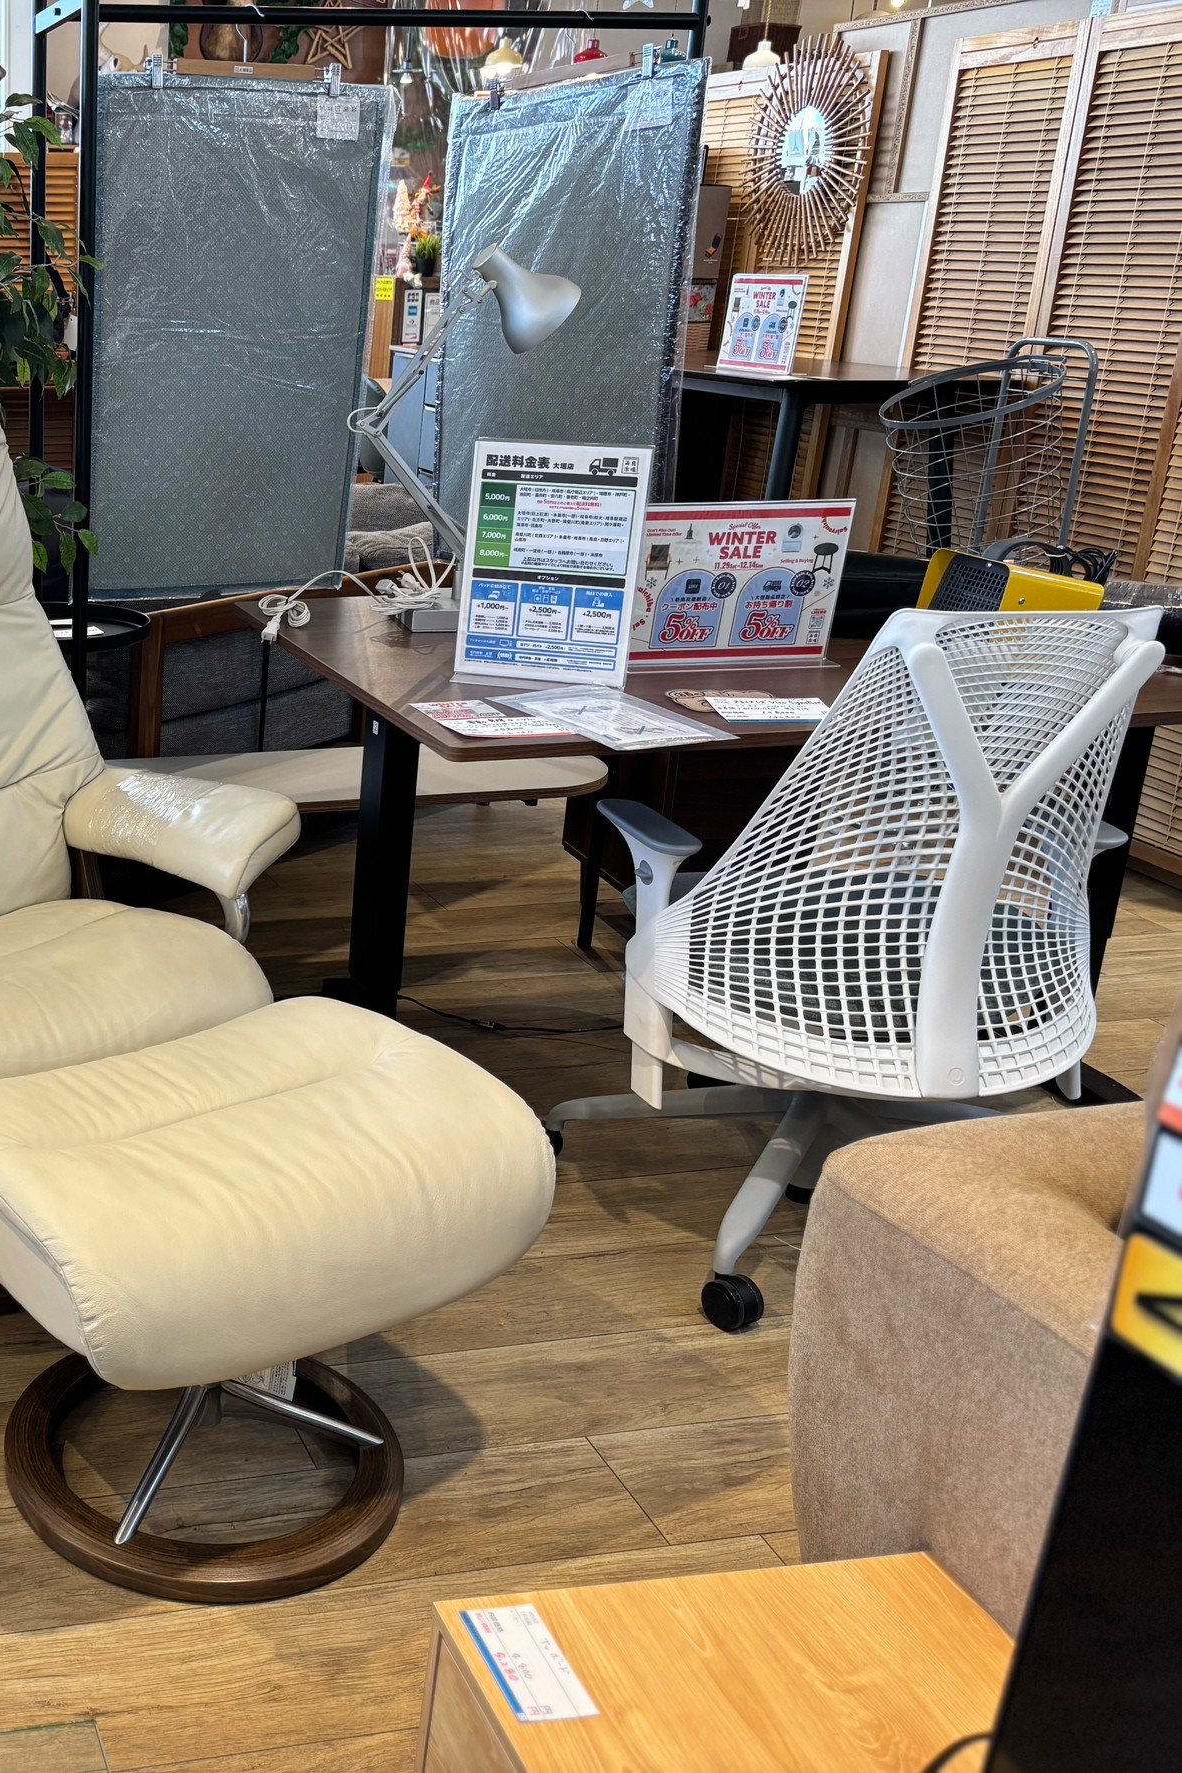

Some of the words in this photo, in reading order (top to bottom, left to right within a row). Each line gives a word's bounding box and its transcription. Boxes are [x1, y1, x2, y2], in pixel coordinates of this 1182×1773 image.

[753, 291, 776, 300] WINTER
[756, 300, 771, 308] SALE
[485, 453, 550, 469] 配送料金表
[553, 462, 574, 470] 大垣店
[484, 493, 510, 501] 5,000円
[747, 522, 761, 530] Offer
[481, 531, 506, 539] 7,000円
[708, 531, 777, 546] WINTER
[719, 546, 762, 560] SALE
[797, 578, 810, 589] 02
[661, 602, 718, 611] クーポン配布中
[744, 601, 793, 609] お持ち帰り割
[582, 611, 612, 619] +2,500円
[527, 1705, 540, 1716] 円
[540, 1705, 554, 1715] 円
